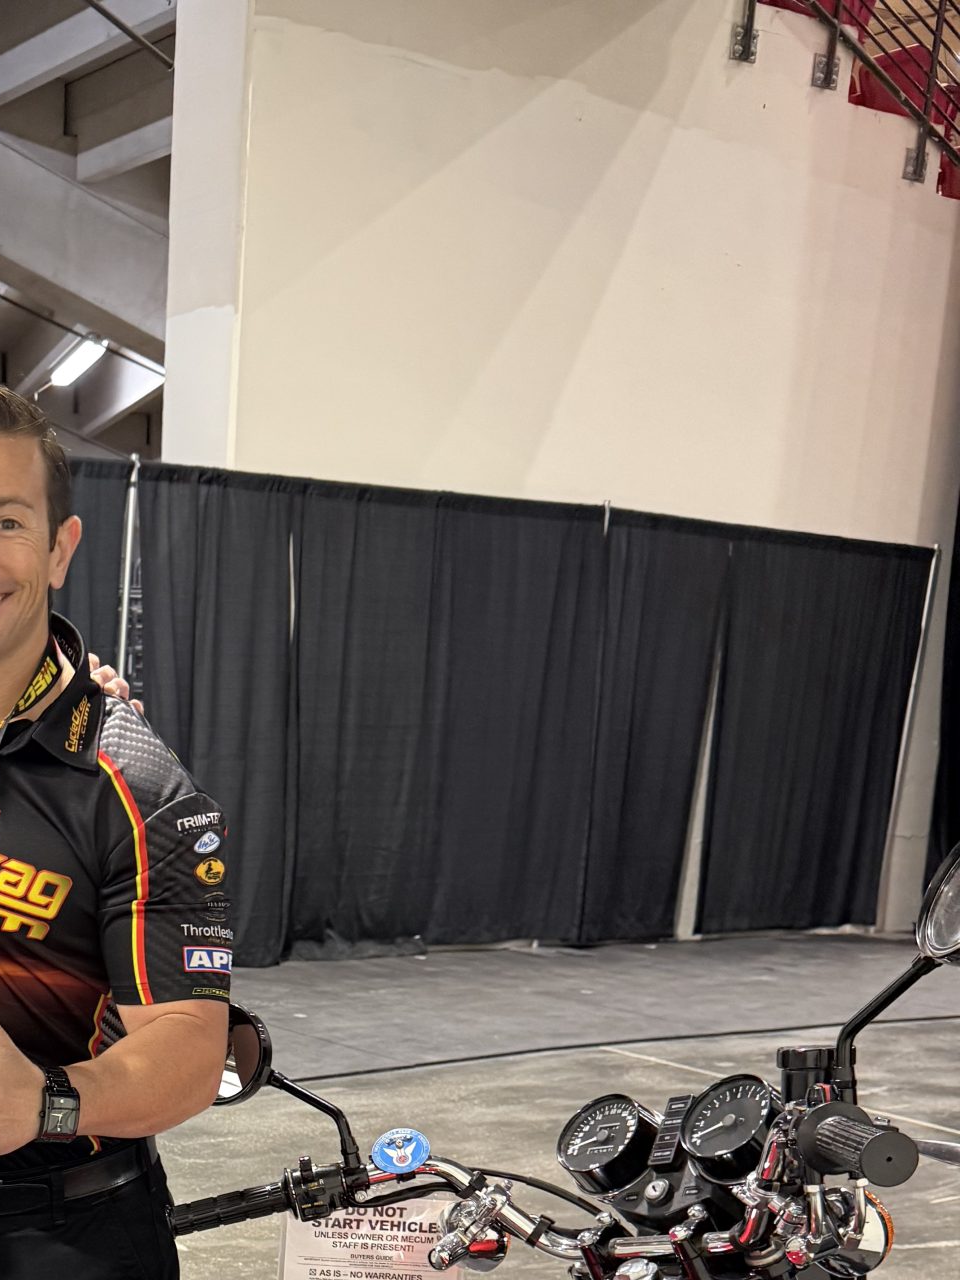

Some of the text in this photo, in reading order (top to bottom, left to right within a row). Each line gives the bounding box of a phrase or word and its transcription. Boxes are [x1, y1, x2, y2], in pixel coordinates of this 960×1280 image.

[345, 1206, 407, 1219] DO NOT
[312, 1217, 364, 1230] START
[314, 1230, 434, 1244] UNLESS OWNER OR MECUM
[332, 1240, 414, 1253] STAFF IS PRESENT!
[319, 1269, 331, 1278] AS
[333, 1270, 341, 1278] IS
[349, 1271, 363, 1279] NO
